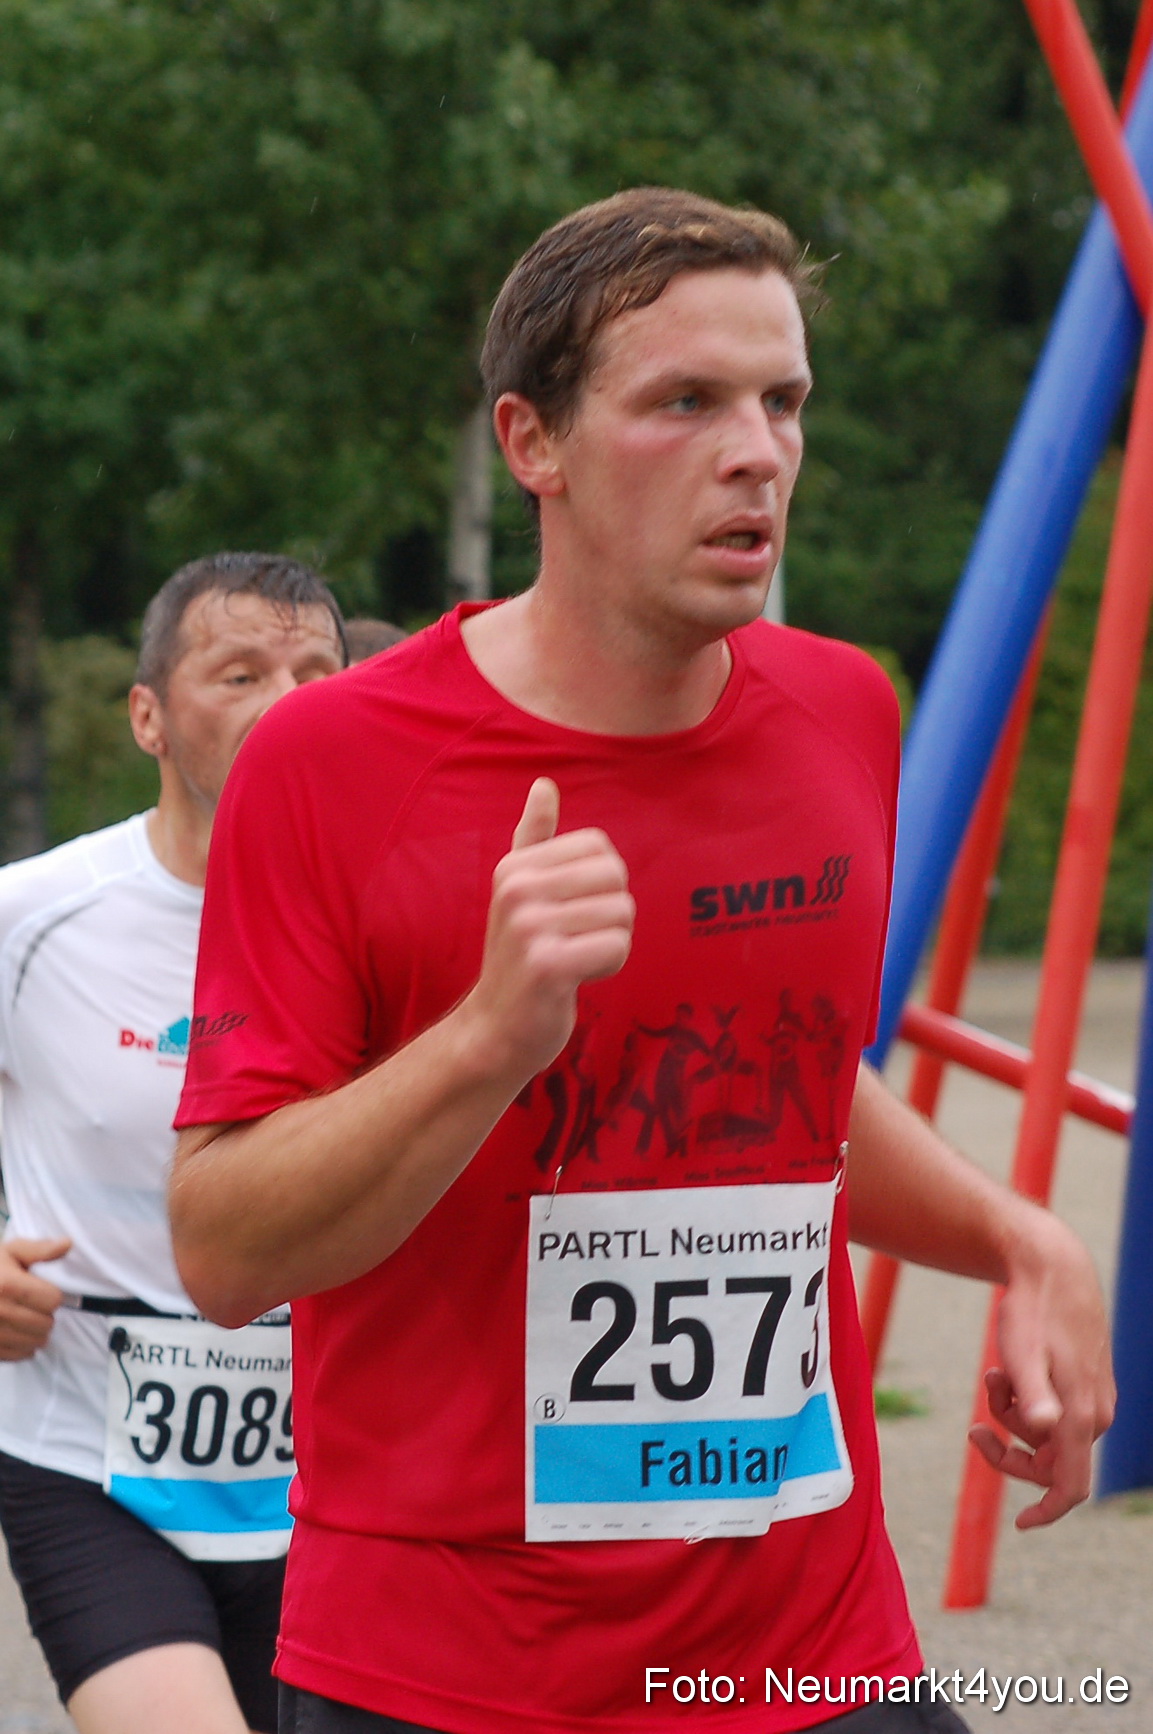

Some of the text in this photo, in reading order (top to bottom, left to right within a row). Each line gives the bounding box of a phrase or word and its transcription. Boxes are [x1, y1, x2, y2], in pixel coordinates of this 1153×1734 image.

[690, 873, 805, 922] swn
[120, 1029, 153, 1051] Die
[538, 1222, 829, 1262] PARTL Neumarkt
[568, 1265, 826, 1403] 2573
[206, 1349, 292, 1371] Neumar
[640, 1437, 789, 1488] Fabian
